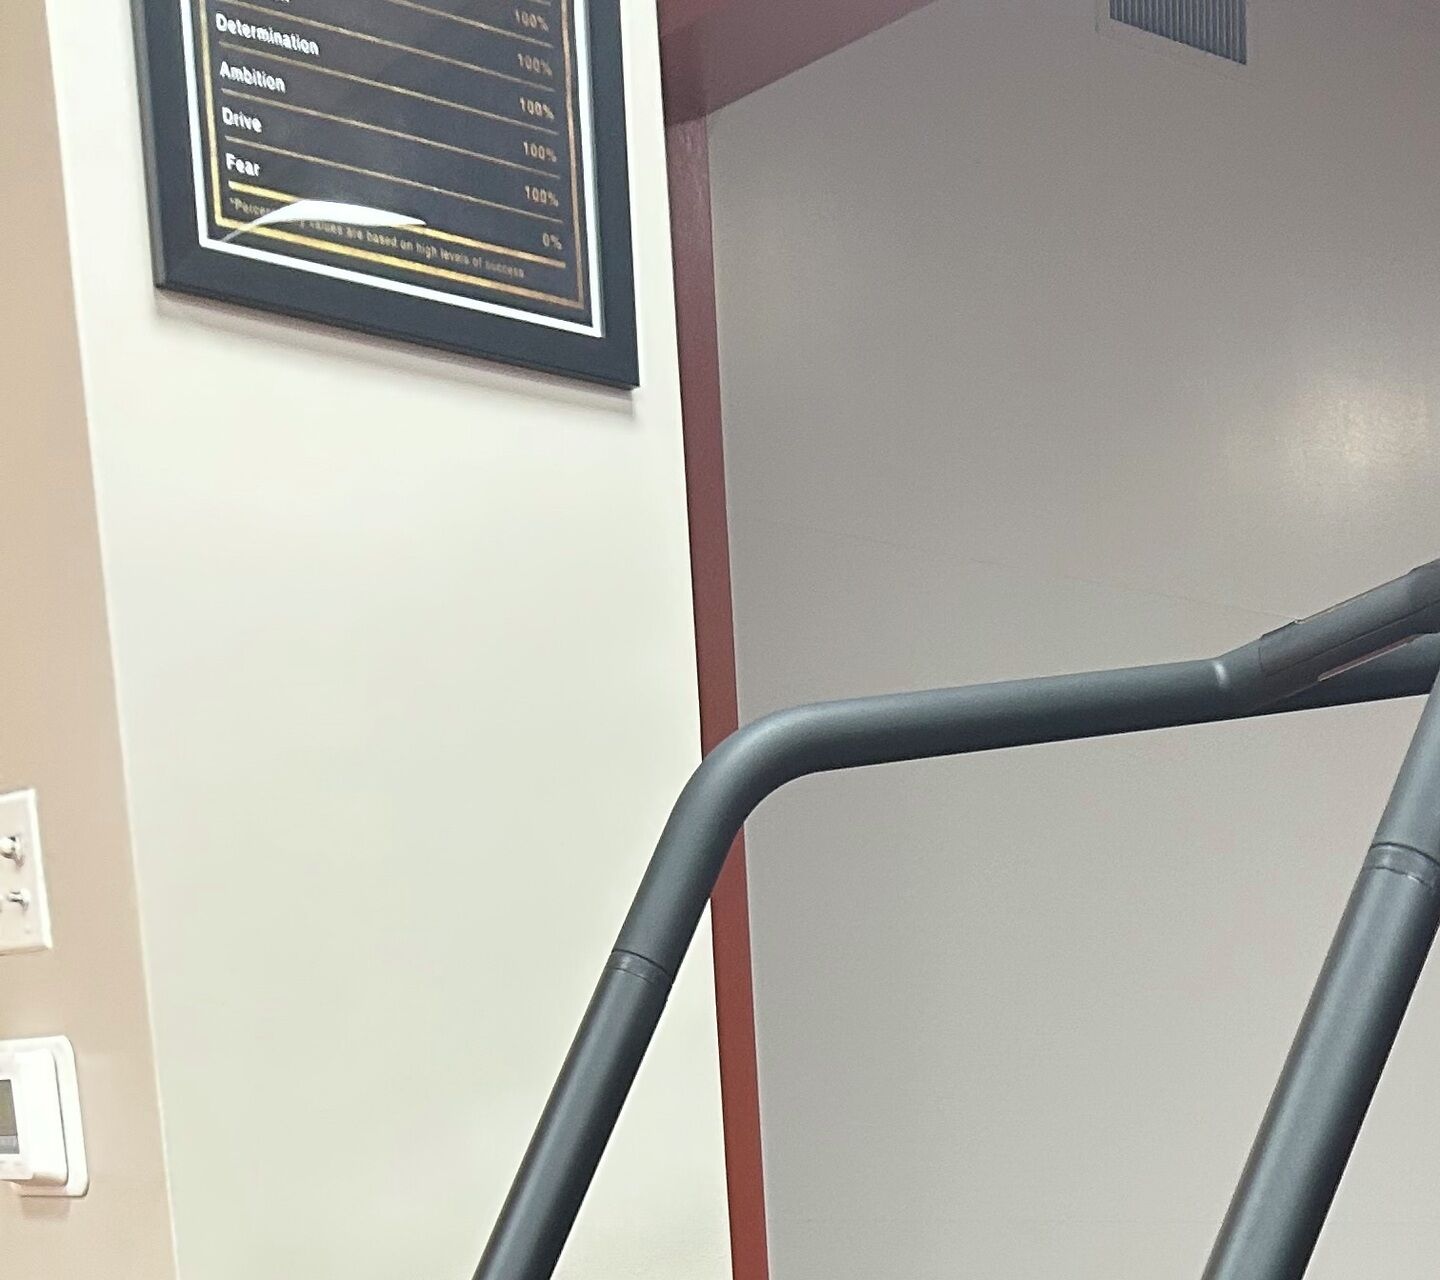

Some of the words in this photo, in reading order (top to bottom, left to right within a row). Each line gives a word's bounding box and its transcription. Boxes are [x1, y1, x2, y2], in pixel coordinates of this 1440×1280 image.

[515, 8, 550, 32] 100%
[215, 11, 320, 56] Determination
[219, 60, 286, 94] Ambition
[517, 53, 553, 77] 100%
[221, 106, 263, 133] Drive
[520, 97, 555, 120] 100%
[523, 141, 557, 163] 100%
[225, 152, 261, 177] Fear
[524, 185, 559, 208] 100%
[367, 230, 397, 248] based
[416, 241, 437, 259] high
[542, 232, 562, 250] 0%
